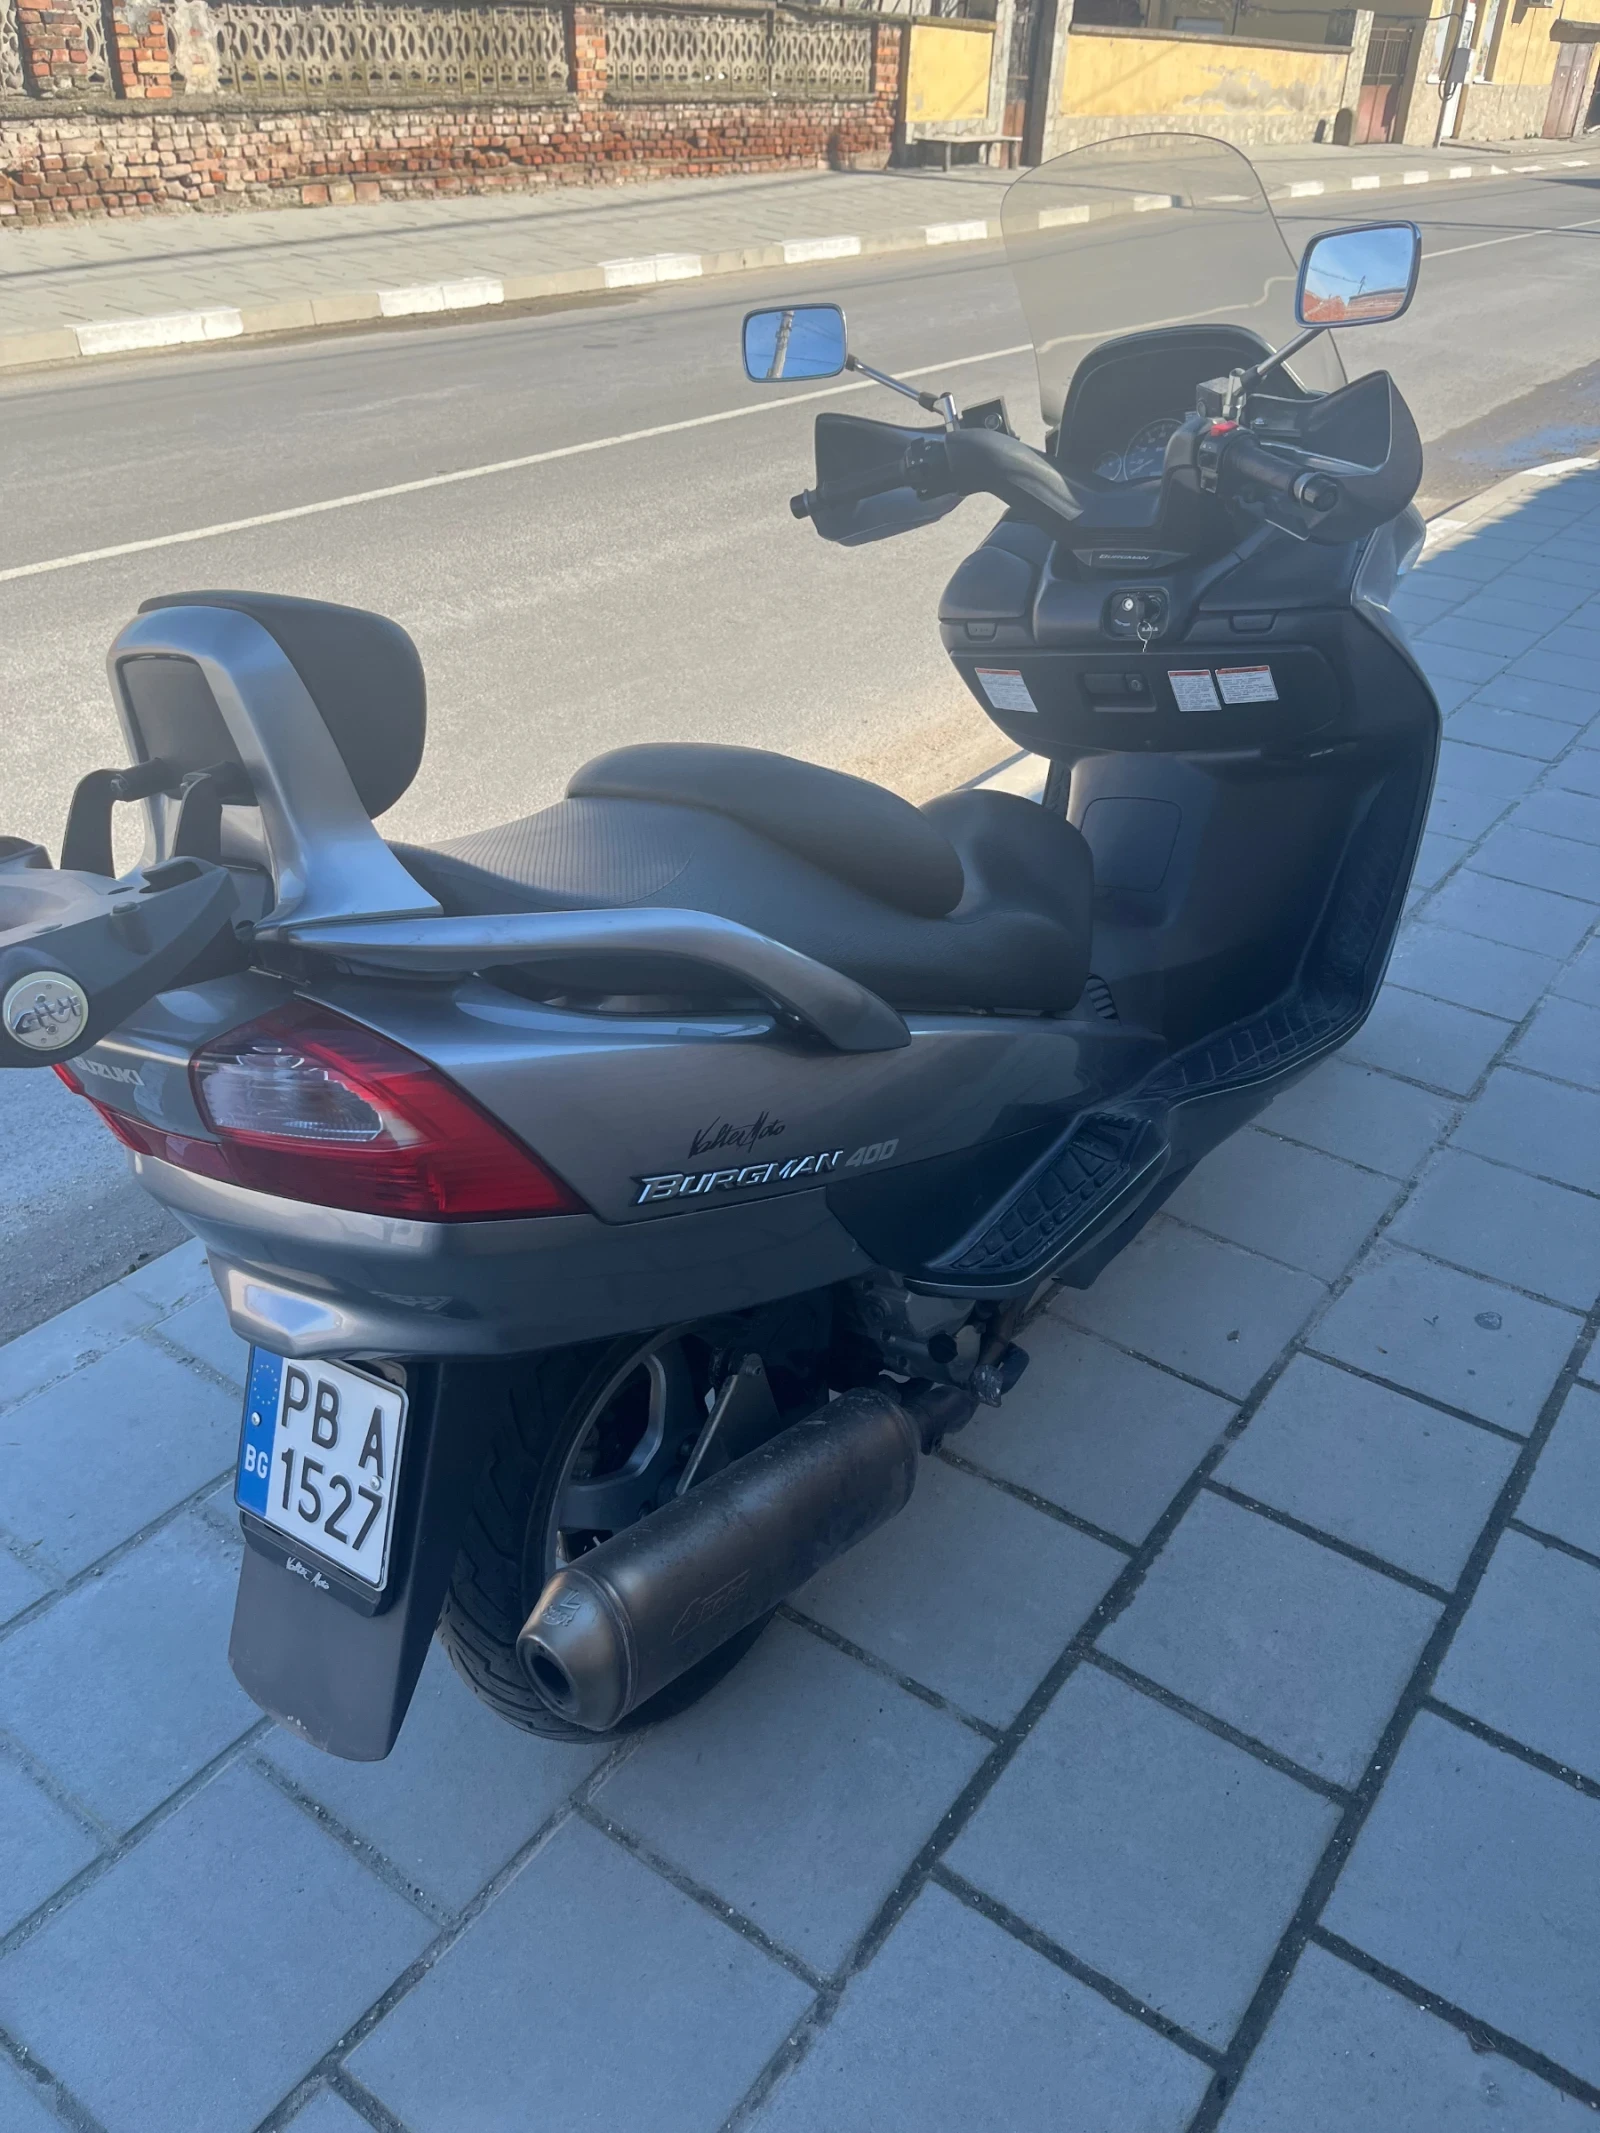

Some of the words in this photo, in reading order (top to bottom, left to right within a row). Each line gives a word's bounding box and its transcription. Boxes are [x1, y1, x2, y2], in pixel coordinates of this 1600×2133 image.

[73, 1057, 145, 1086] SUZUKI
[632, 1150, 844, 1206] BURGMAN
[845, 1138, 899, 1168] 400
[281, 1365, 341, 1450] PB
[358, 1407, 385, 1479] A
[244, 1444, 269, 1479] BG
[281, 1447, 383, 1551] 1527
